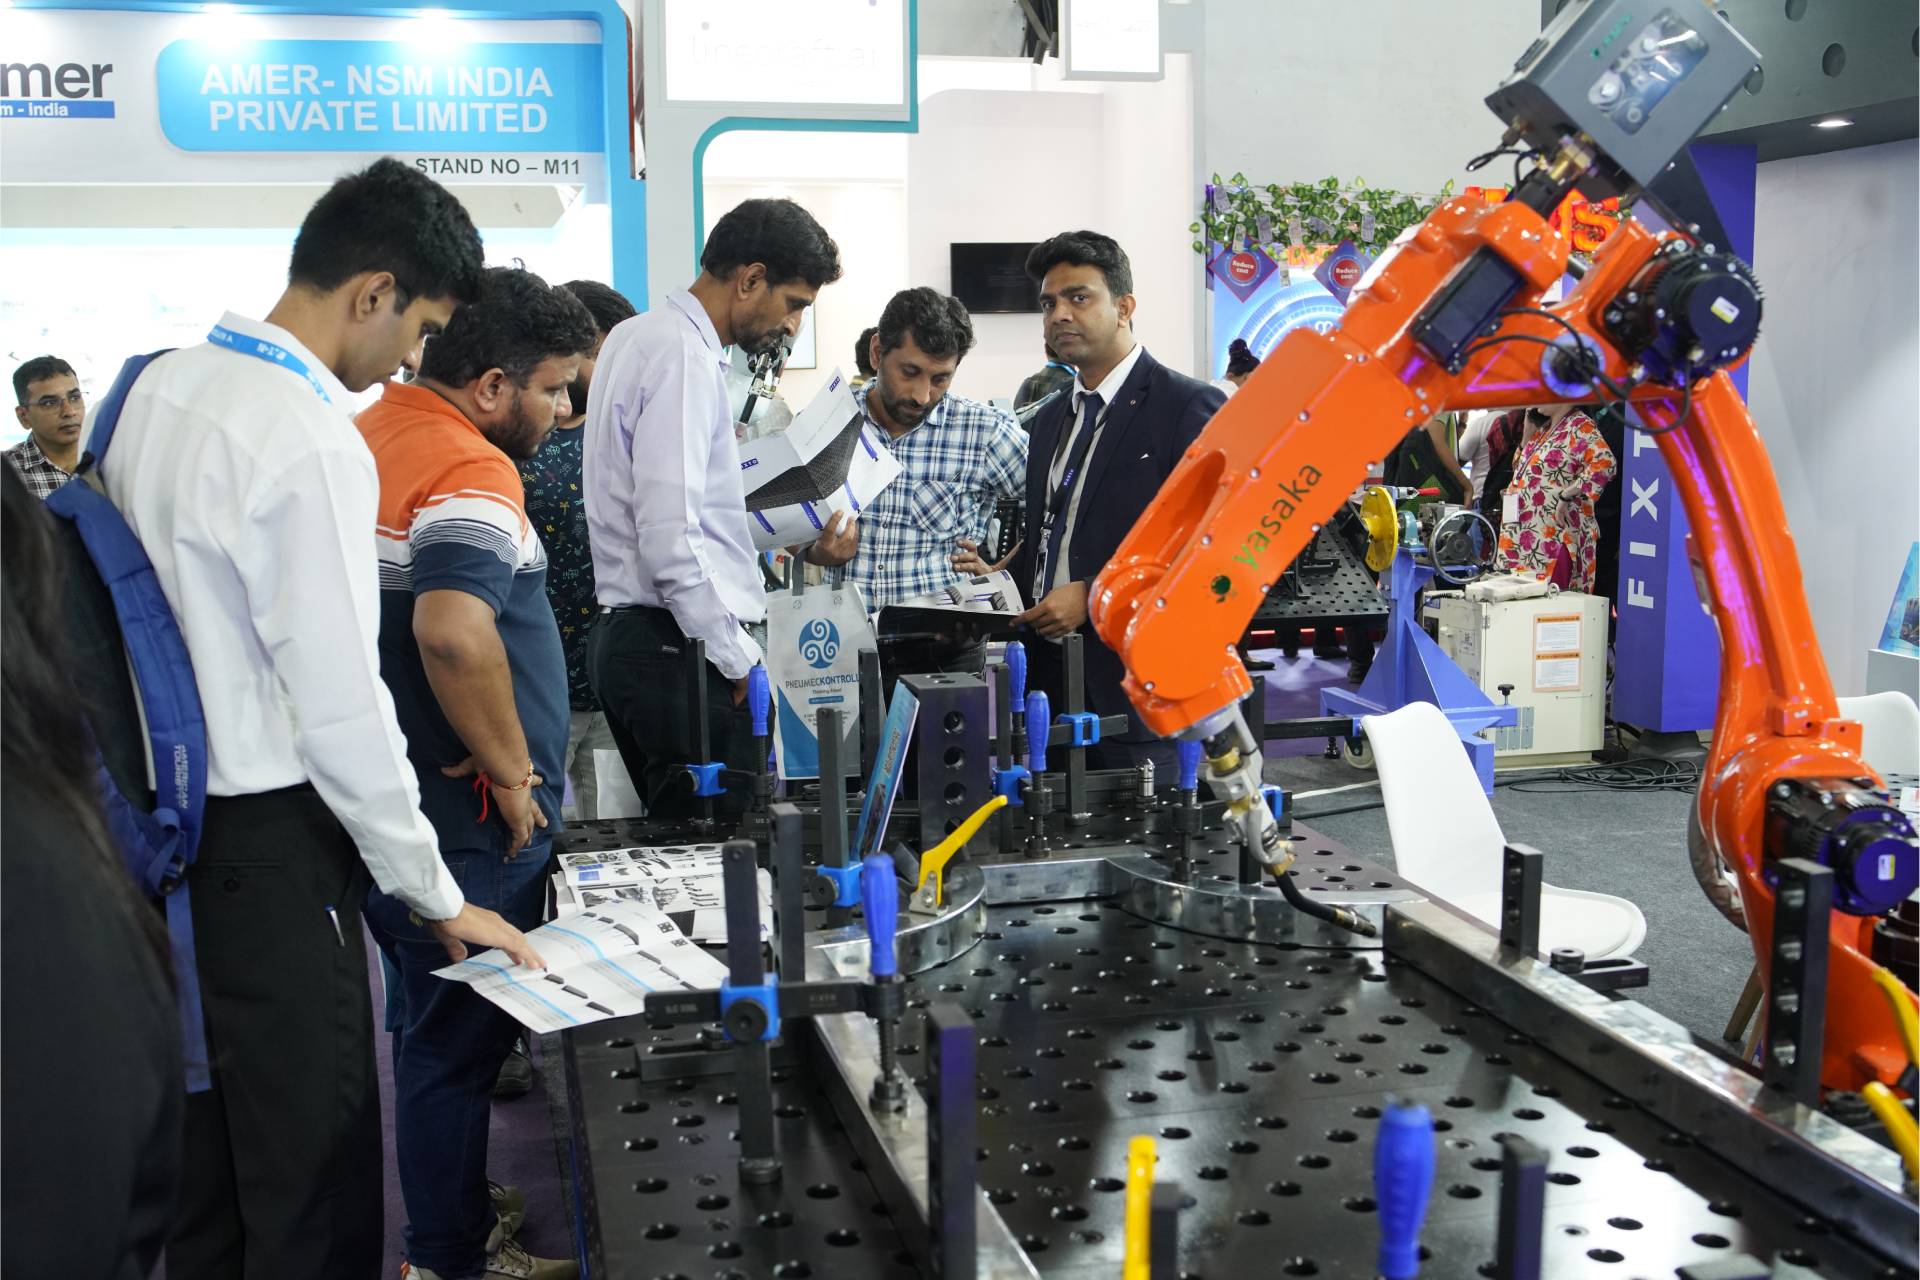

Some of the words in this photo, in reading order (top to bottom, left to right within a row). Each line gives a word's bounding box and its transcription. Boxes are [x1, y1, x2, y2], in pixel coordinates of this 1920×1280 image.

[200, 63, 335, 96] AMER-
[347, 64, 433, 97] NSM
[447, 66, 553, 97] INDIA
[28, 102, 69, 117] india
[209, 100, 379, 132] PRIVATE
[392, 101, 548, 133] LIMITED
[415, 158, 483, 174] STAND
[491, 158, 520, 175] NO
[544, 159, 580, 175] M11
[1232, 463, 1322, 570] yasaka
